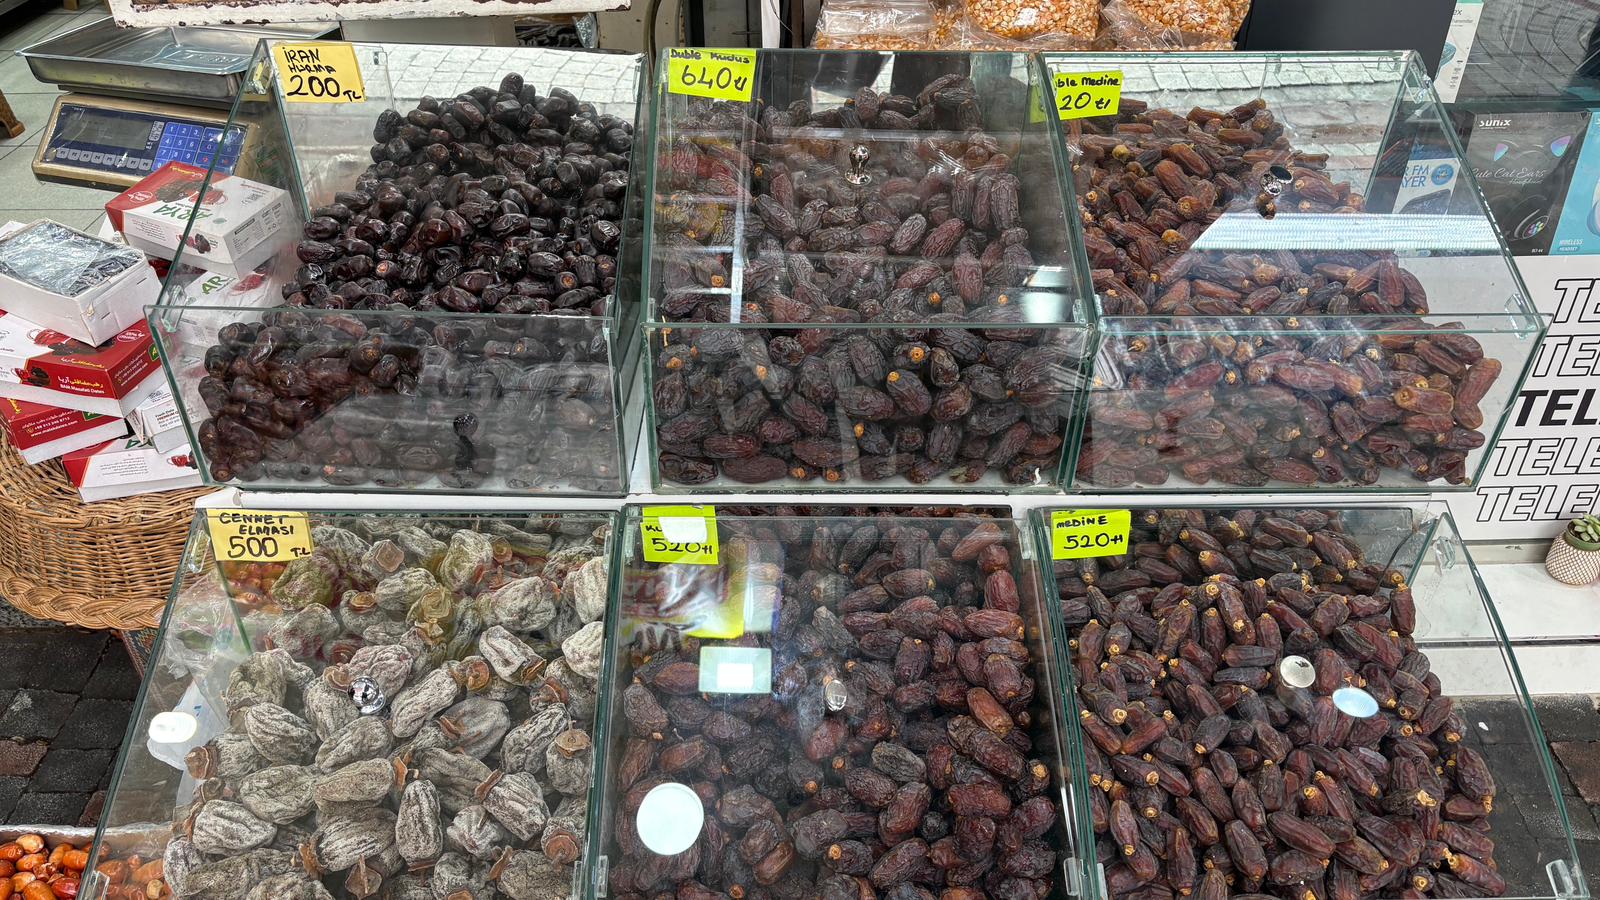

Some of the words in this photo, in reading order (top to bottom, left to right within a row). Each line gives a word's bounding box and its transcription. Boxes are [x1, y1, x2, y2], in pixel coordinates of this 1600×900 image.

[670, 49, 701, 60] Duble
[288, 62, 336, 74] HURMA
[287, 75, 340, 97] 200
[343, 90, 362, 102] TL
[1055, 78, 1078, 88] ble
[1494, 167, 1516, 178] Cat
[1532, 334, 1600, 377] TE
[1476, 484, 1600, 522] TELE
[219, 512, 290, 525] CENNET
[227, 536, 279, 559] 500
